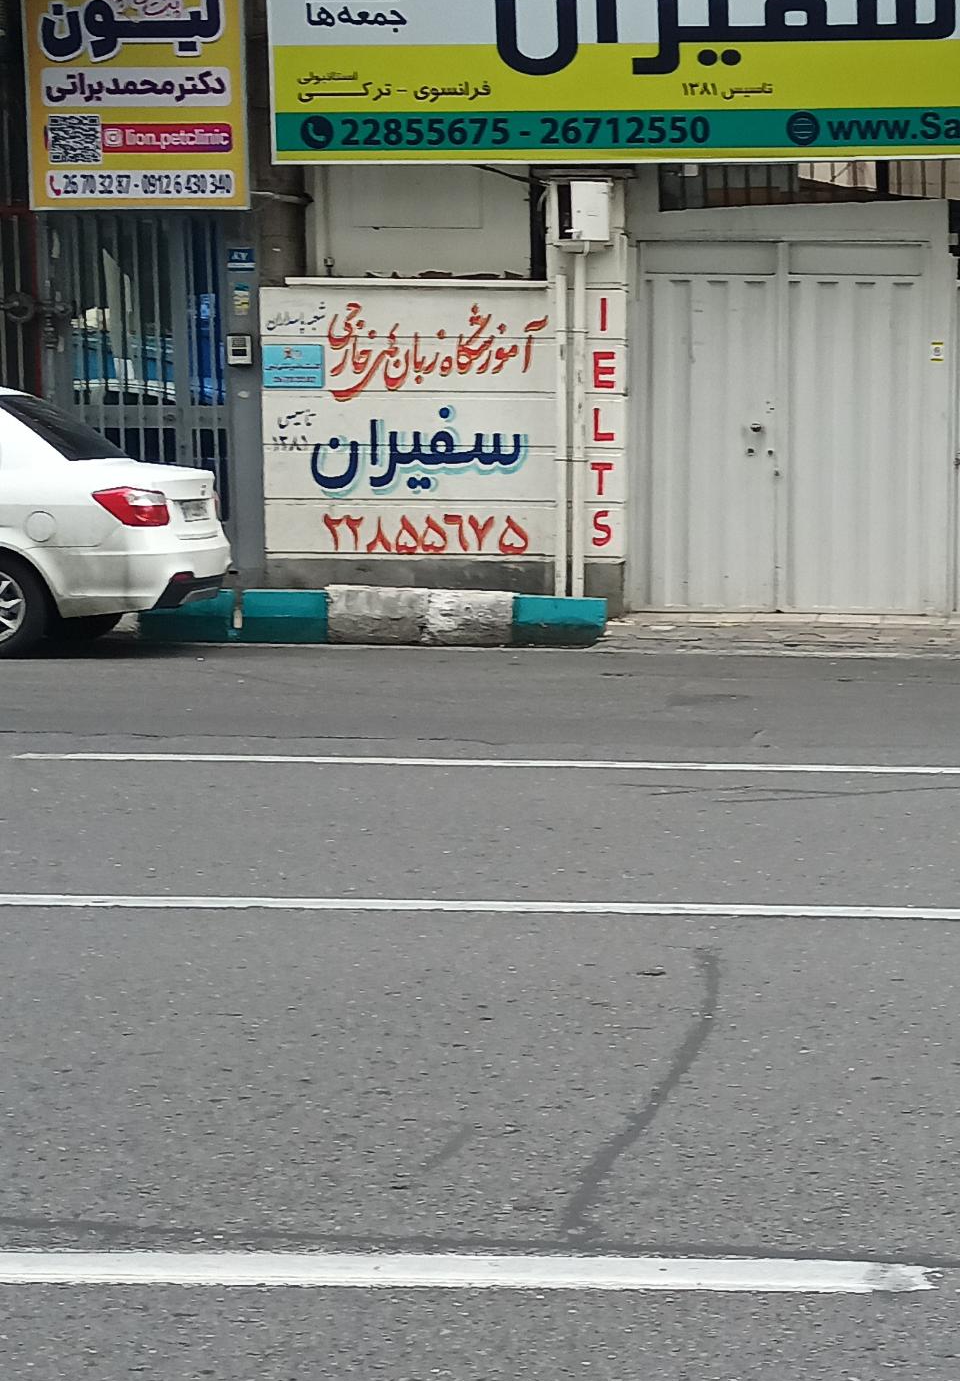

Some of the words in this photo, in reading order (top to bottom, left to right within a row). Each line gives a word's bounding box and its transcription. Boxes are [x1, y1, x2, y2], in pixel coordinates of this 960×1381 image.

[297, 81, 392, 103] ترکی
[413, 81, 491, 103] فرانسوی
[681, 82, 718, 96] ۱۳۸۱
[340, 117, 510, 146] 22855675
[540, 116, 710, 145] 26712550
[98, 174, 114, 194] 32
[439, 303, 549, 377] آموزشگاه
[311, 406, 526, 494] سفیران
